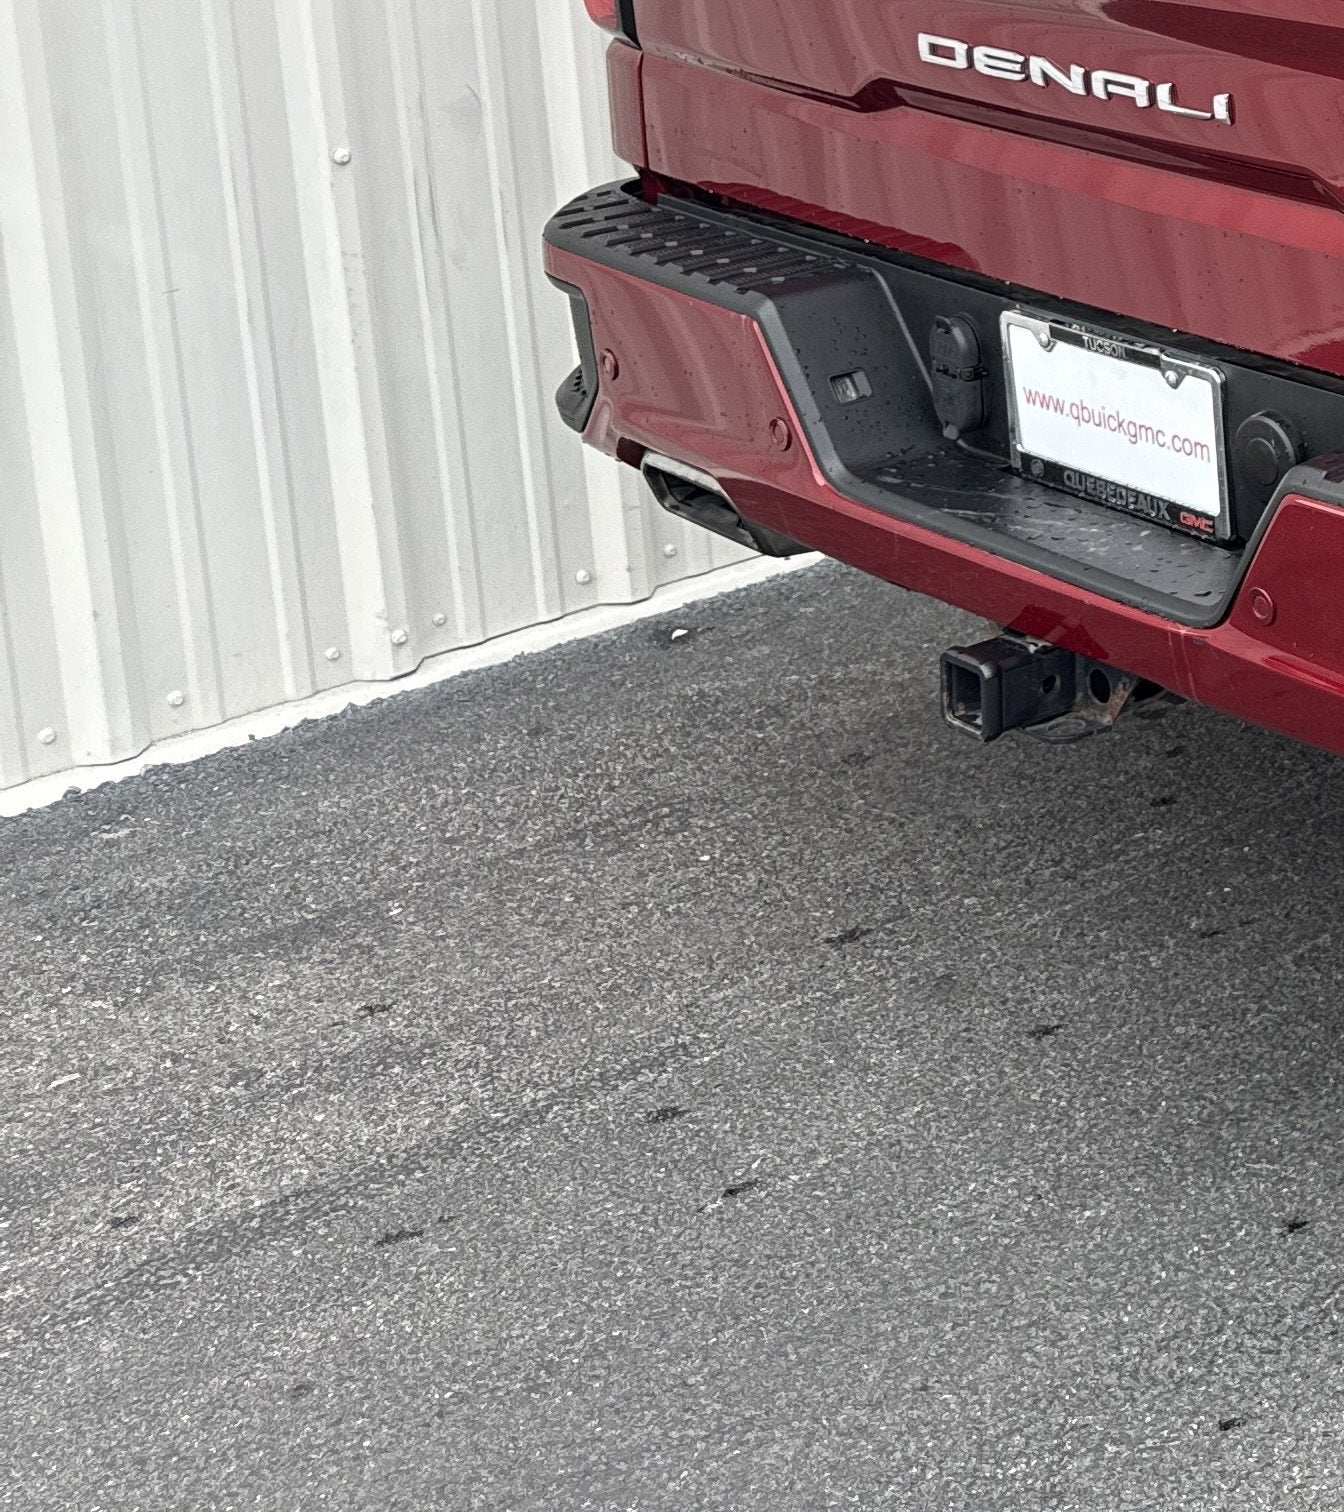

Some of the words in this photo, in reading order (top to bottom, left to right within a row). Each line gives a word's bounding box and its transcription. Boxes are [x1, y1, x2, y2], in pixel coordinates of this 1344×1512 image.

[917, 31, 1236, 127] DENALI
[1081, 334, 1127, 361] TUCSON
[1023, 386, 1211, 464] www.qbuickgmc.com
[1062, 469, 1171, 522] QUEBEDEAUX
[1178, 510, 1214, 534] GMC
